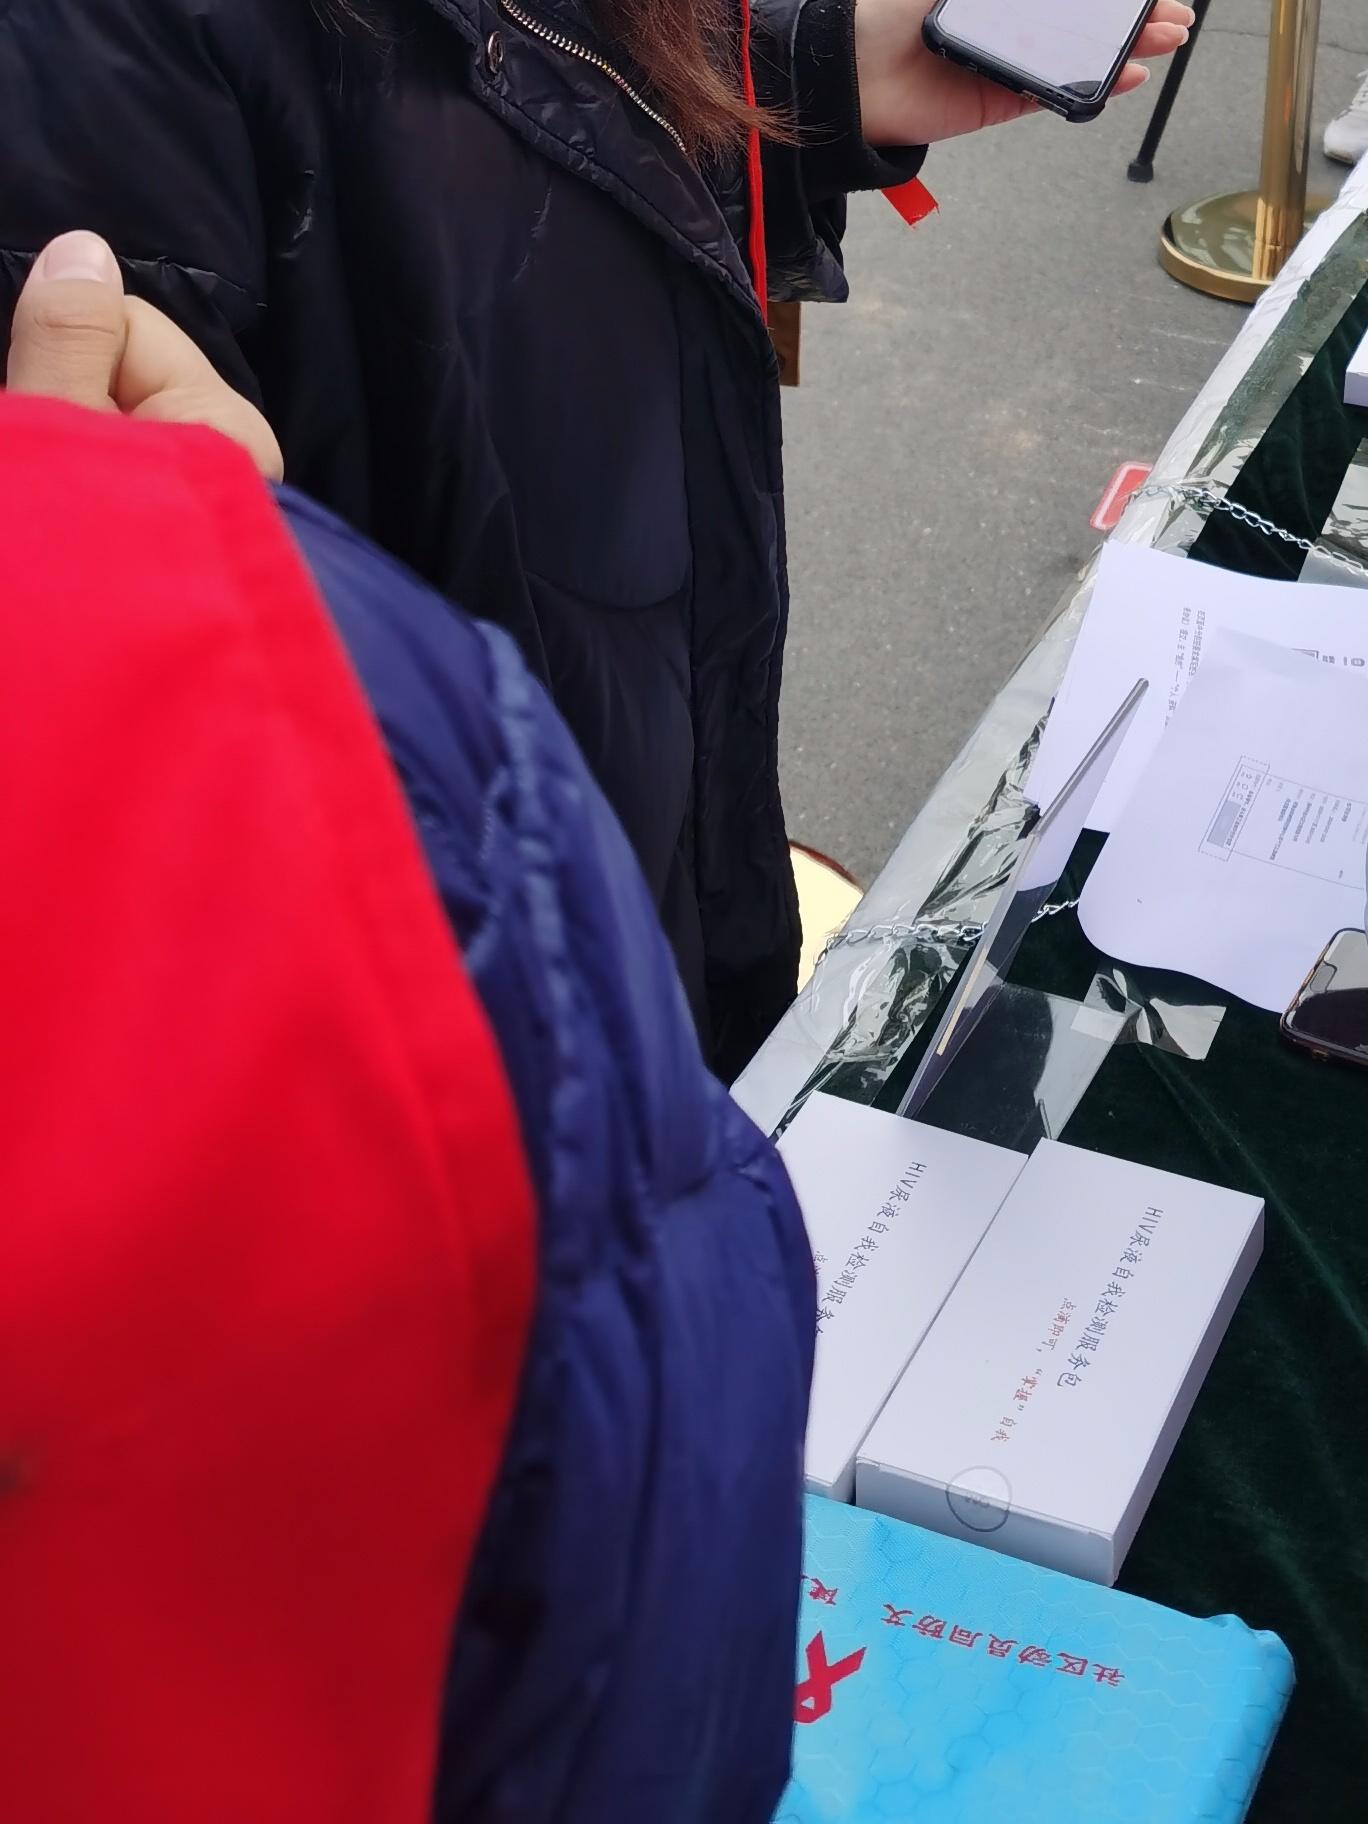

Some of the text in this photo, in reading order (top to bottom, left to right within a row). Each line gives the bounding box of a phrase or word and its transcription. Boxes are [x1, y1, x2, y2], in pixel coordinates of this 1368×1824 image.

[1056, 1205, 1165, 1389] HIV尿液自我检测服务包
